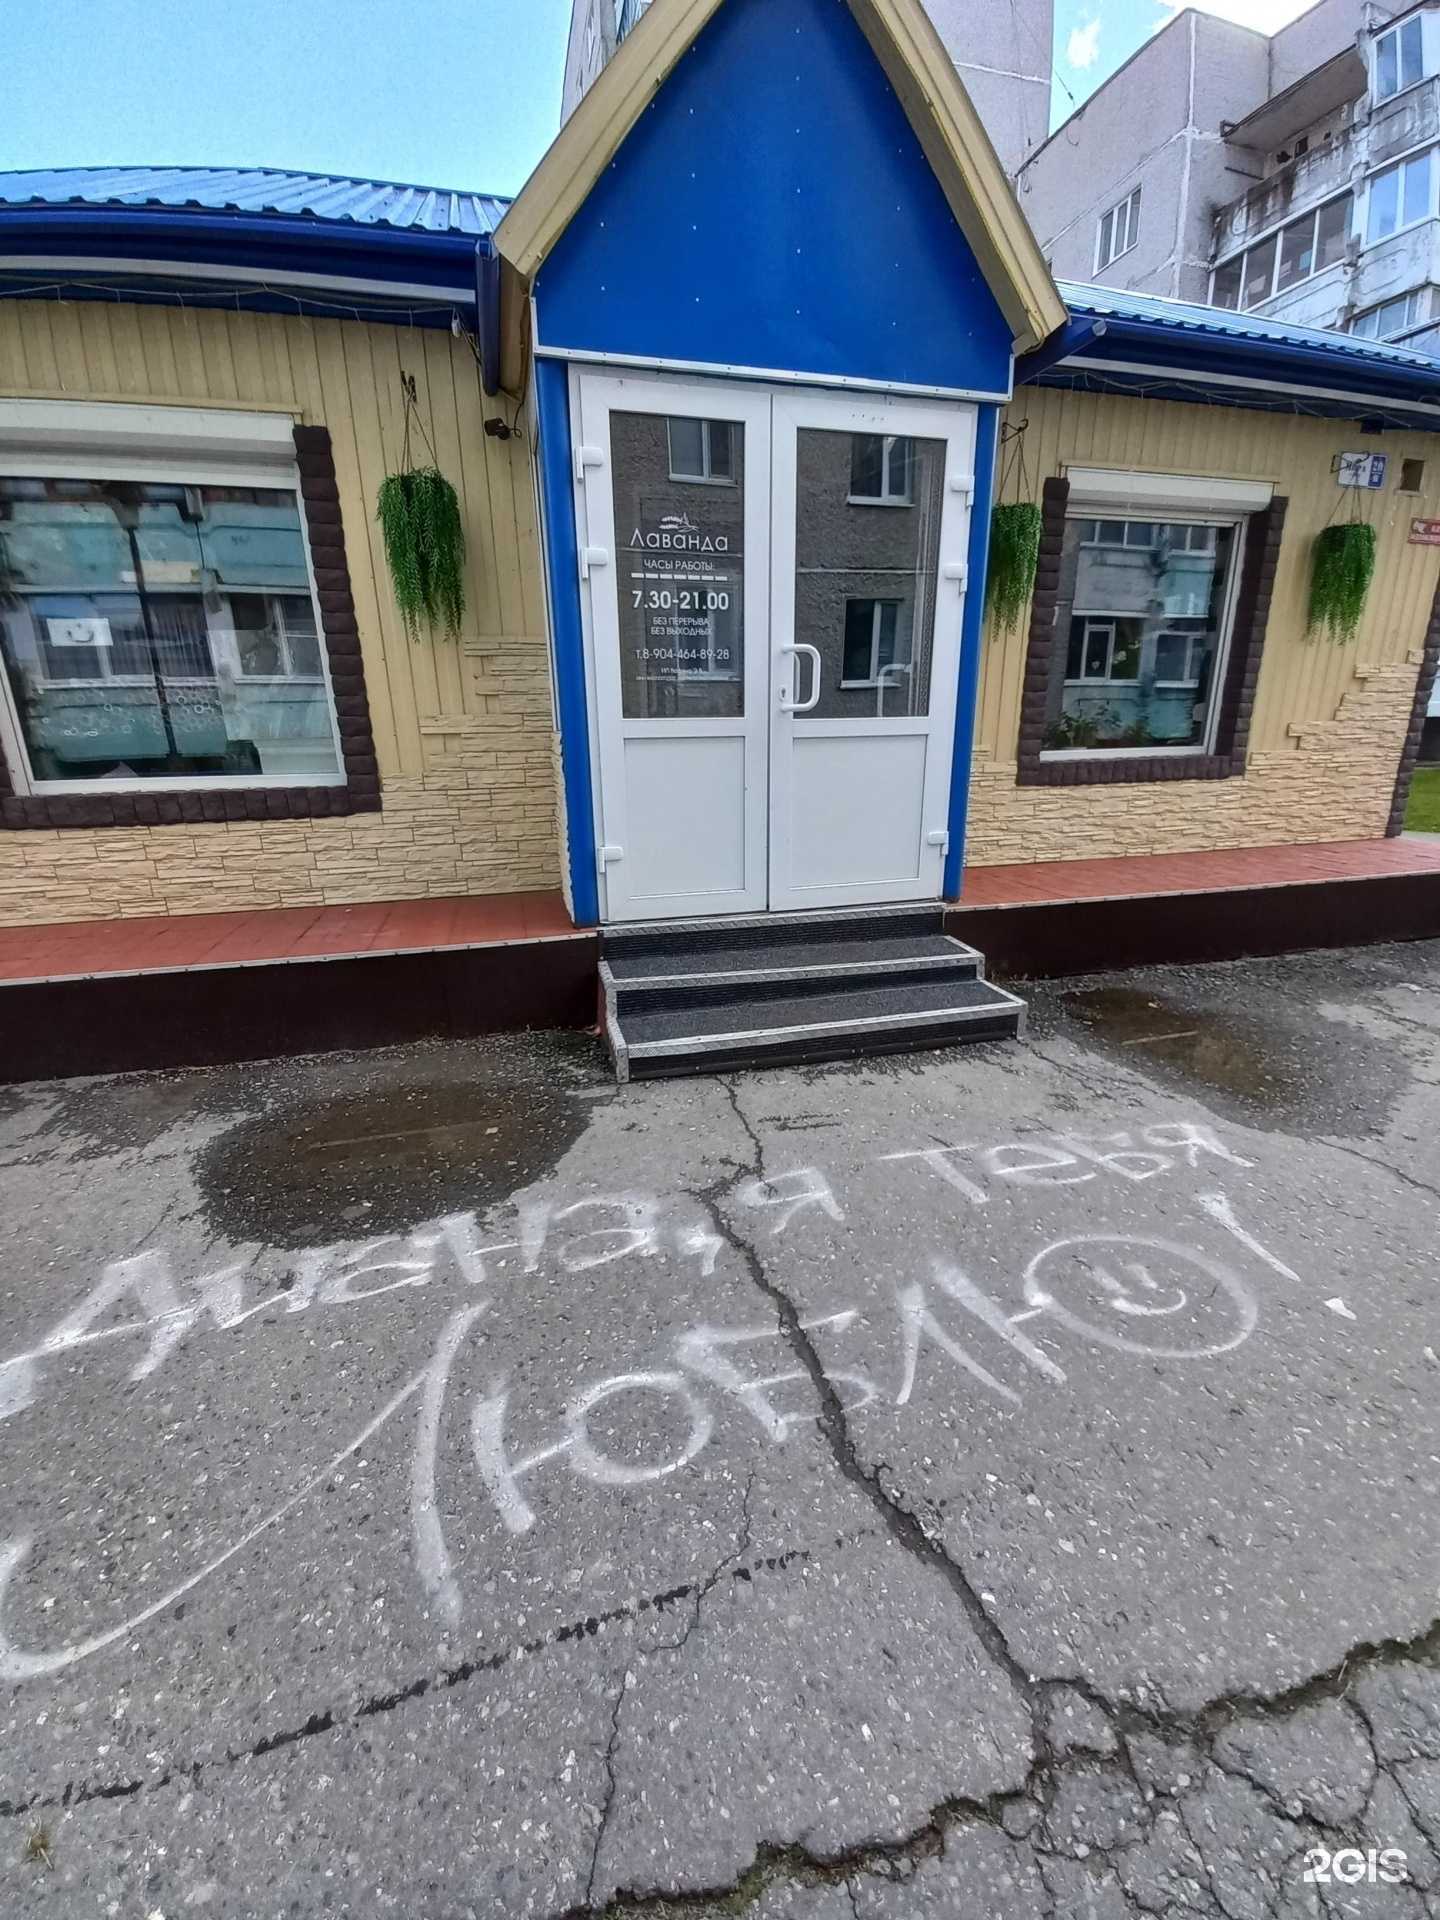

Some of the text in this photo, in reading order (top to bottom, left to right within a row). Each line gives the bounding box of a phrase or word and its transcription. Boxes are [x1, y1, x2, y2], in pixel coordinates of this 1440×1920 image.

[630, 528, 729, 552] Лаванда
[643, 559, 713, 571] ЧАСЫ РАБОТЫ
[631, 590, 729, 610] 7.30-21.00
[652, 616, 668, 626] БЕЗ
[650, 626, 713, 636] БЕЗ ВЫХОДНЫХ
